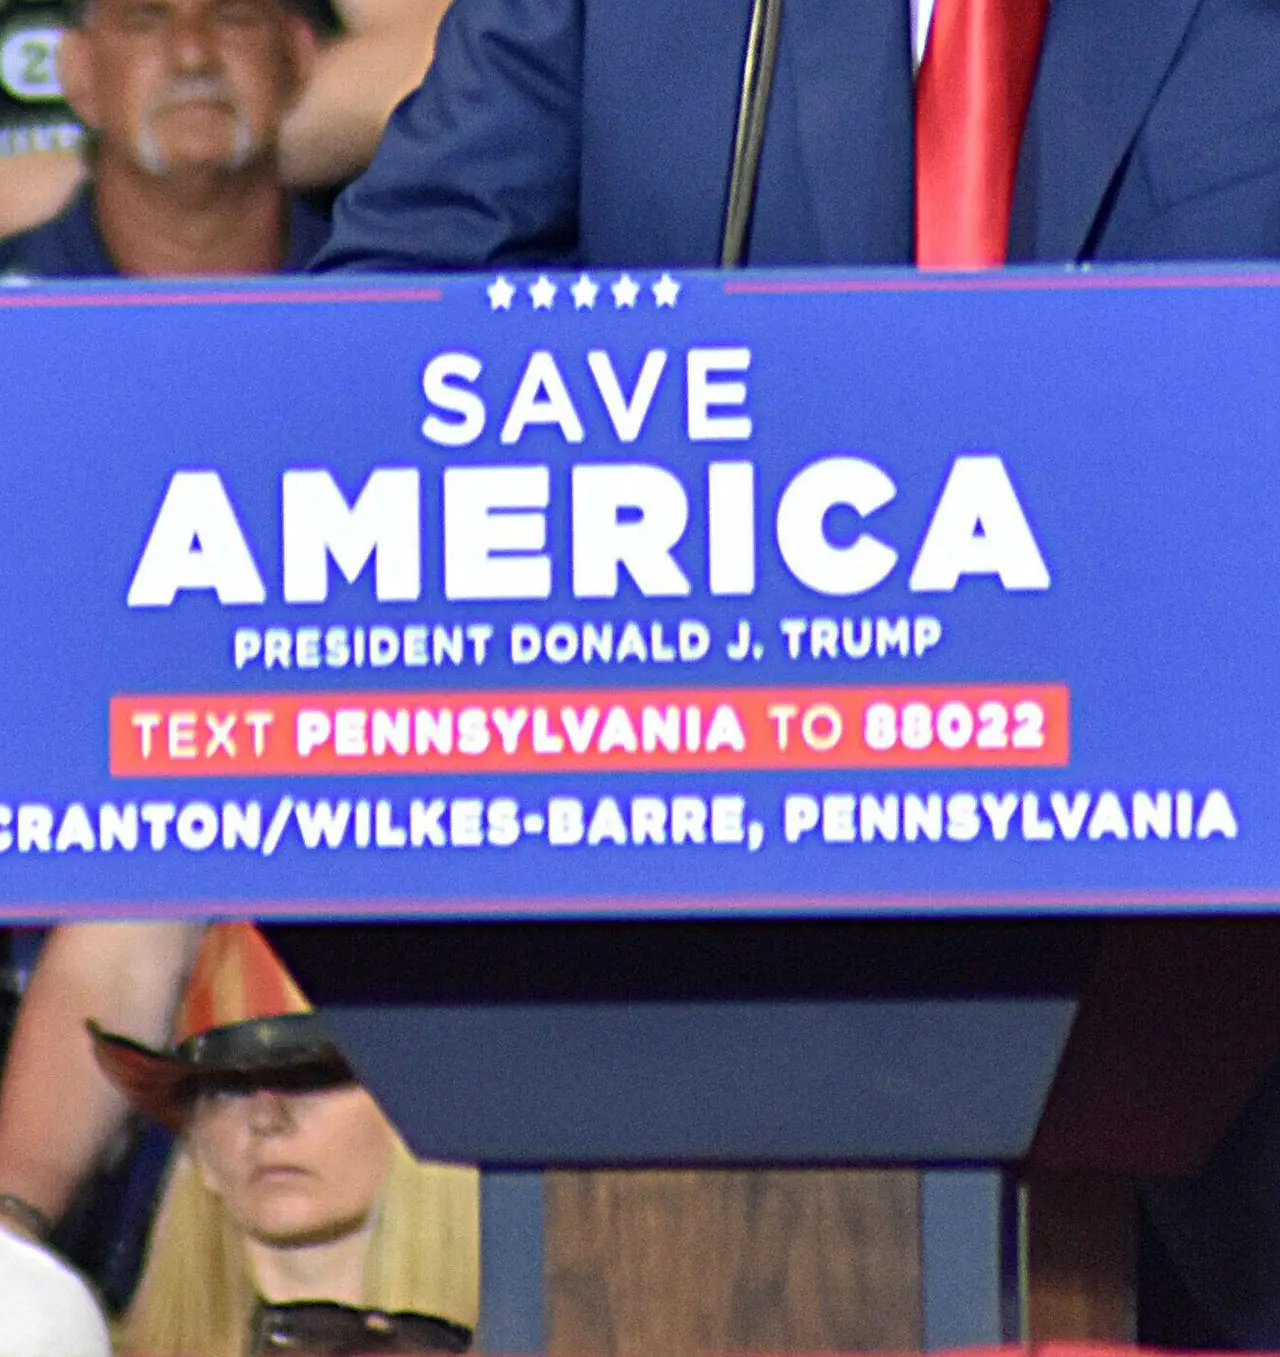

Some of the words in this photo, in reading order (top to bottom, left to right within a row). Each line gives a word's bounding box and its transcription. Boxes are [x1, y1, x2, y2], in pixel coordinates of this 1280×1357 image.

[421, 346, 753, 447] SAVE
[126, 454, 1051, 608] AMERICA
[233, 624, 493, 670] PRESIDENT
[510, 620, 711, 665] DONALD
[726, 619, 764, 661] J.
[780, 615, 942, 660] TRUMP
[130, 711, 275, 760] TEXT
[296, 704, 747, 758] PENNSYLVANIA
[767, 703, 844, 752] TO
[864, 700, 1046, 751] 88022
[783, 788, 1239, 844] PENNSYLVANIA
